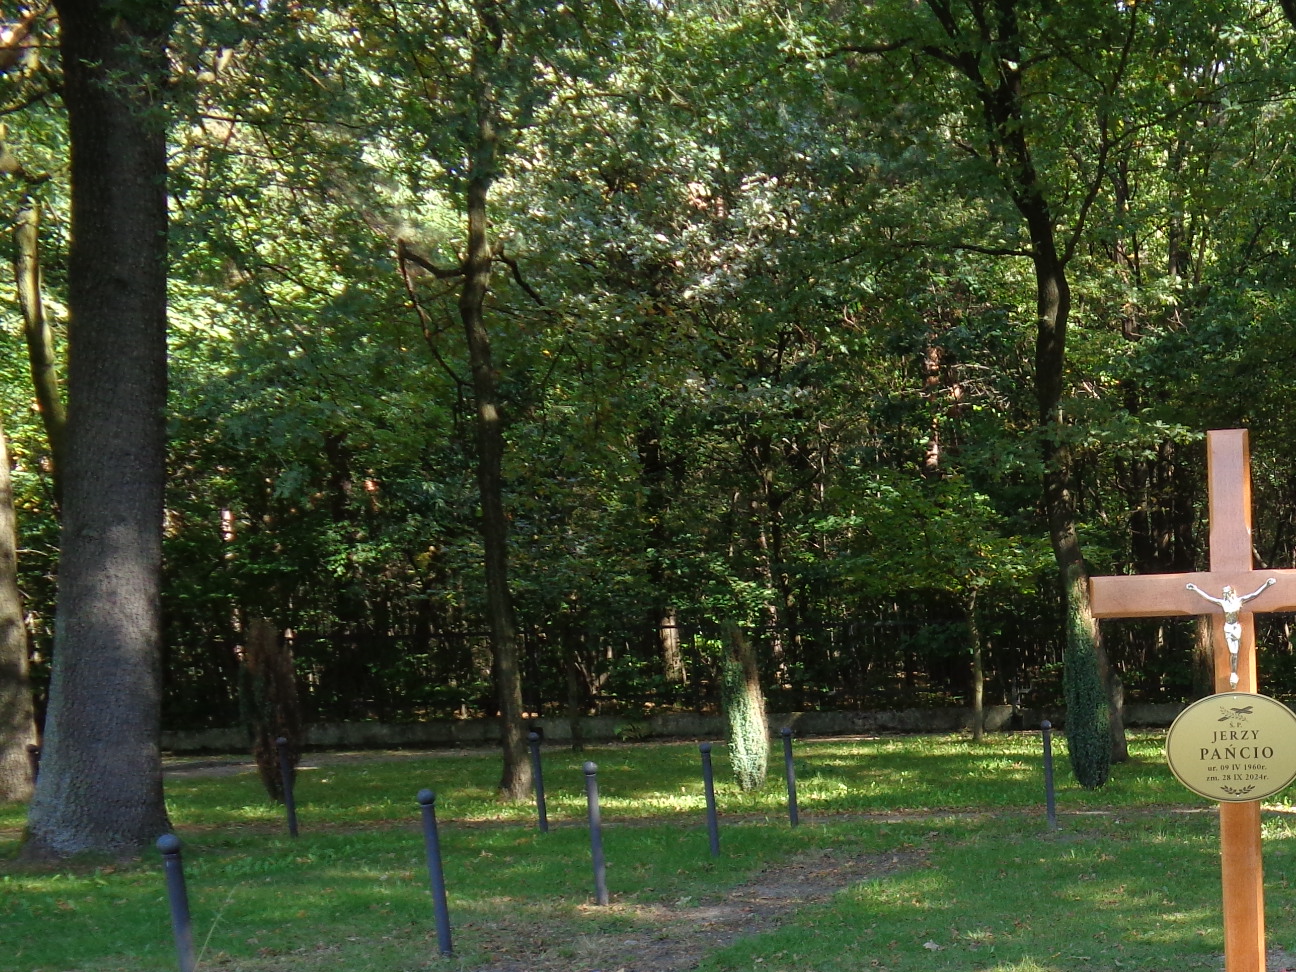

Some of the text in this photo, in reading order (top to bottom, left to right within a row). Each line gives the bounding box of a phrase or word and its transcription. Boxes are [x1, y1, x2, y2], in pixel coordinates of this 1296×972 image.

[1211, 729, 1260, 743] JERZY
[1200, 744, 1274, 760] PAŃCIO
[1243, 763, 1267, 771] 1960r.
